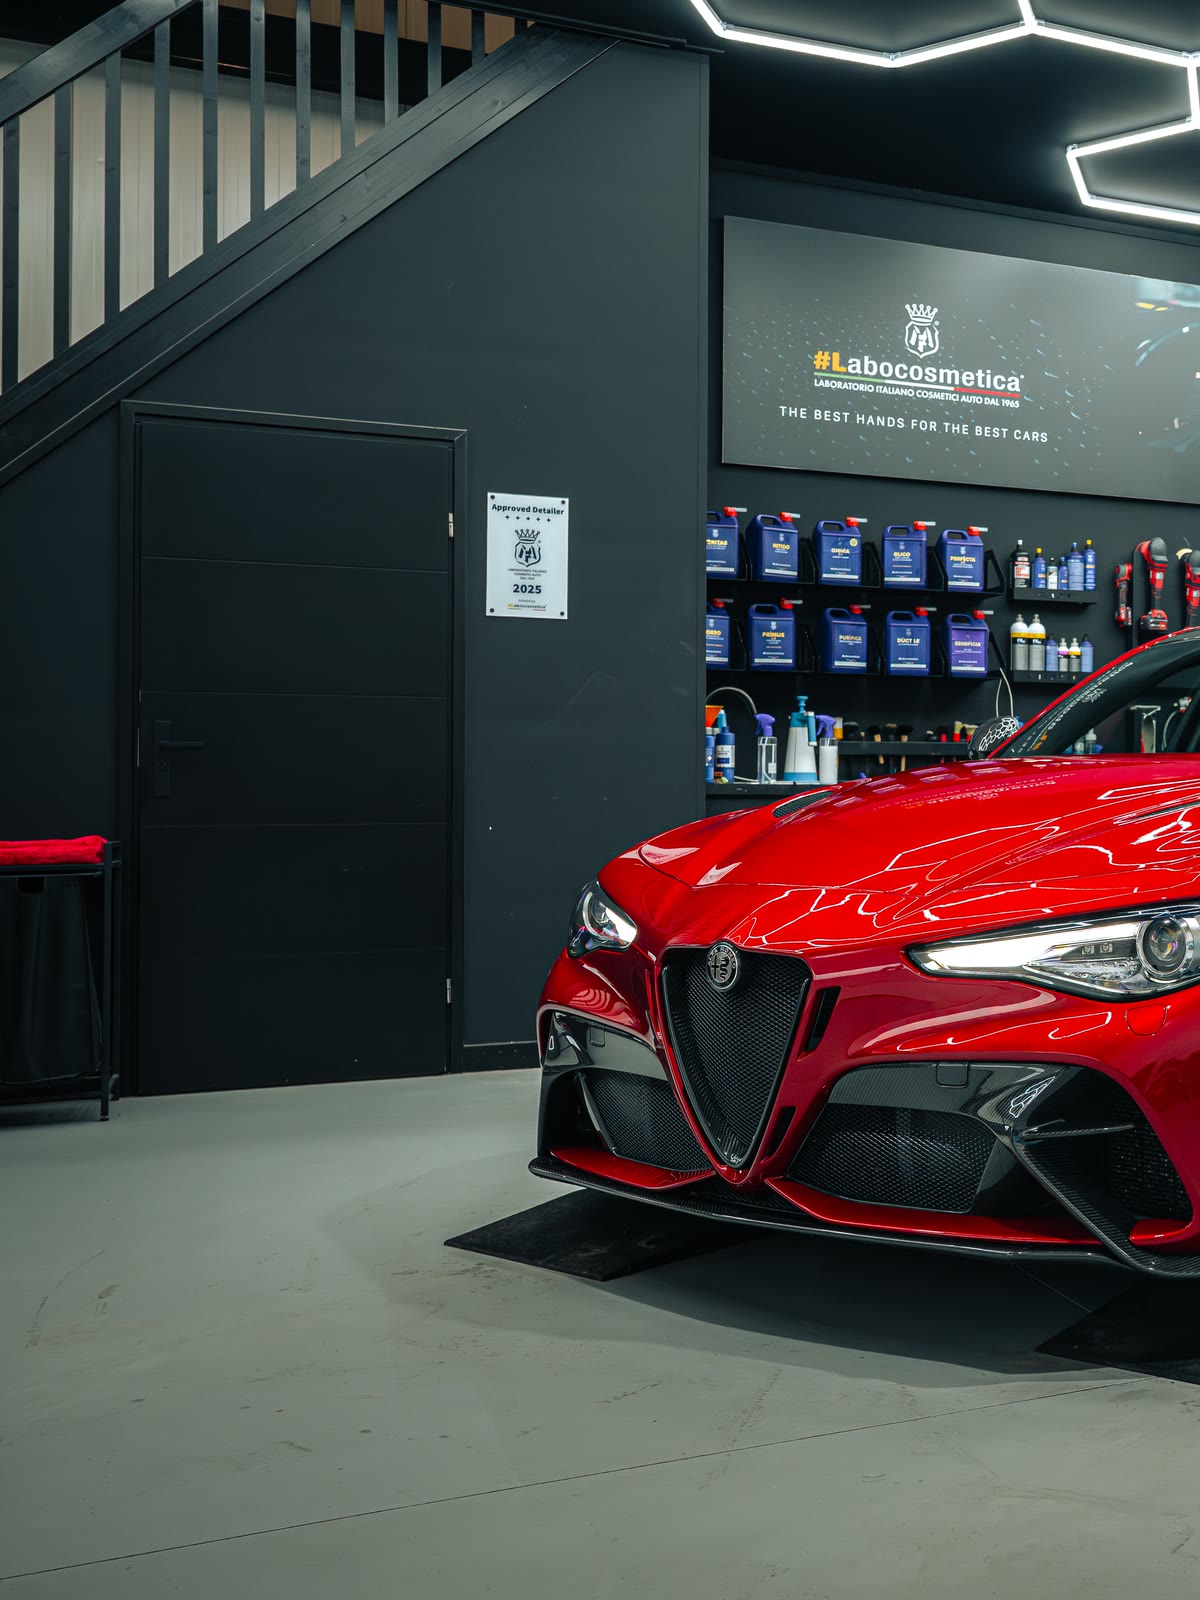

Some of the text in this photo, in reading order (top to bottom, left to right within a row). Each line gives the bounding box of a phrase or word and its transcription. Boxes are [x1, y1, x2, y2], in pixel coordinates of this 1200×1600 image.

[814, 379, 1020, 409] LABORATORIO ITALIANO COSMETICI AUTO DAL 1965
[779, 405, 1048, 443] THE BEST HANDS FOR THE BEST CARS
[491, 503, 565, 516] Approved Detailer
[512, 583, 543, 595] 2025
